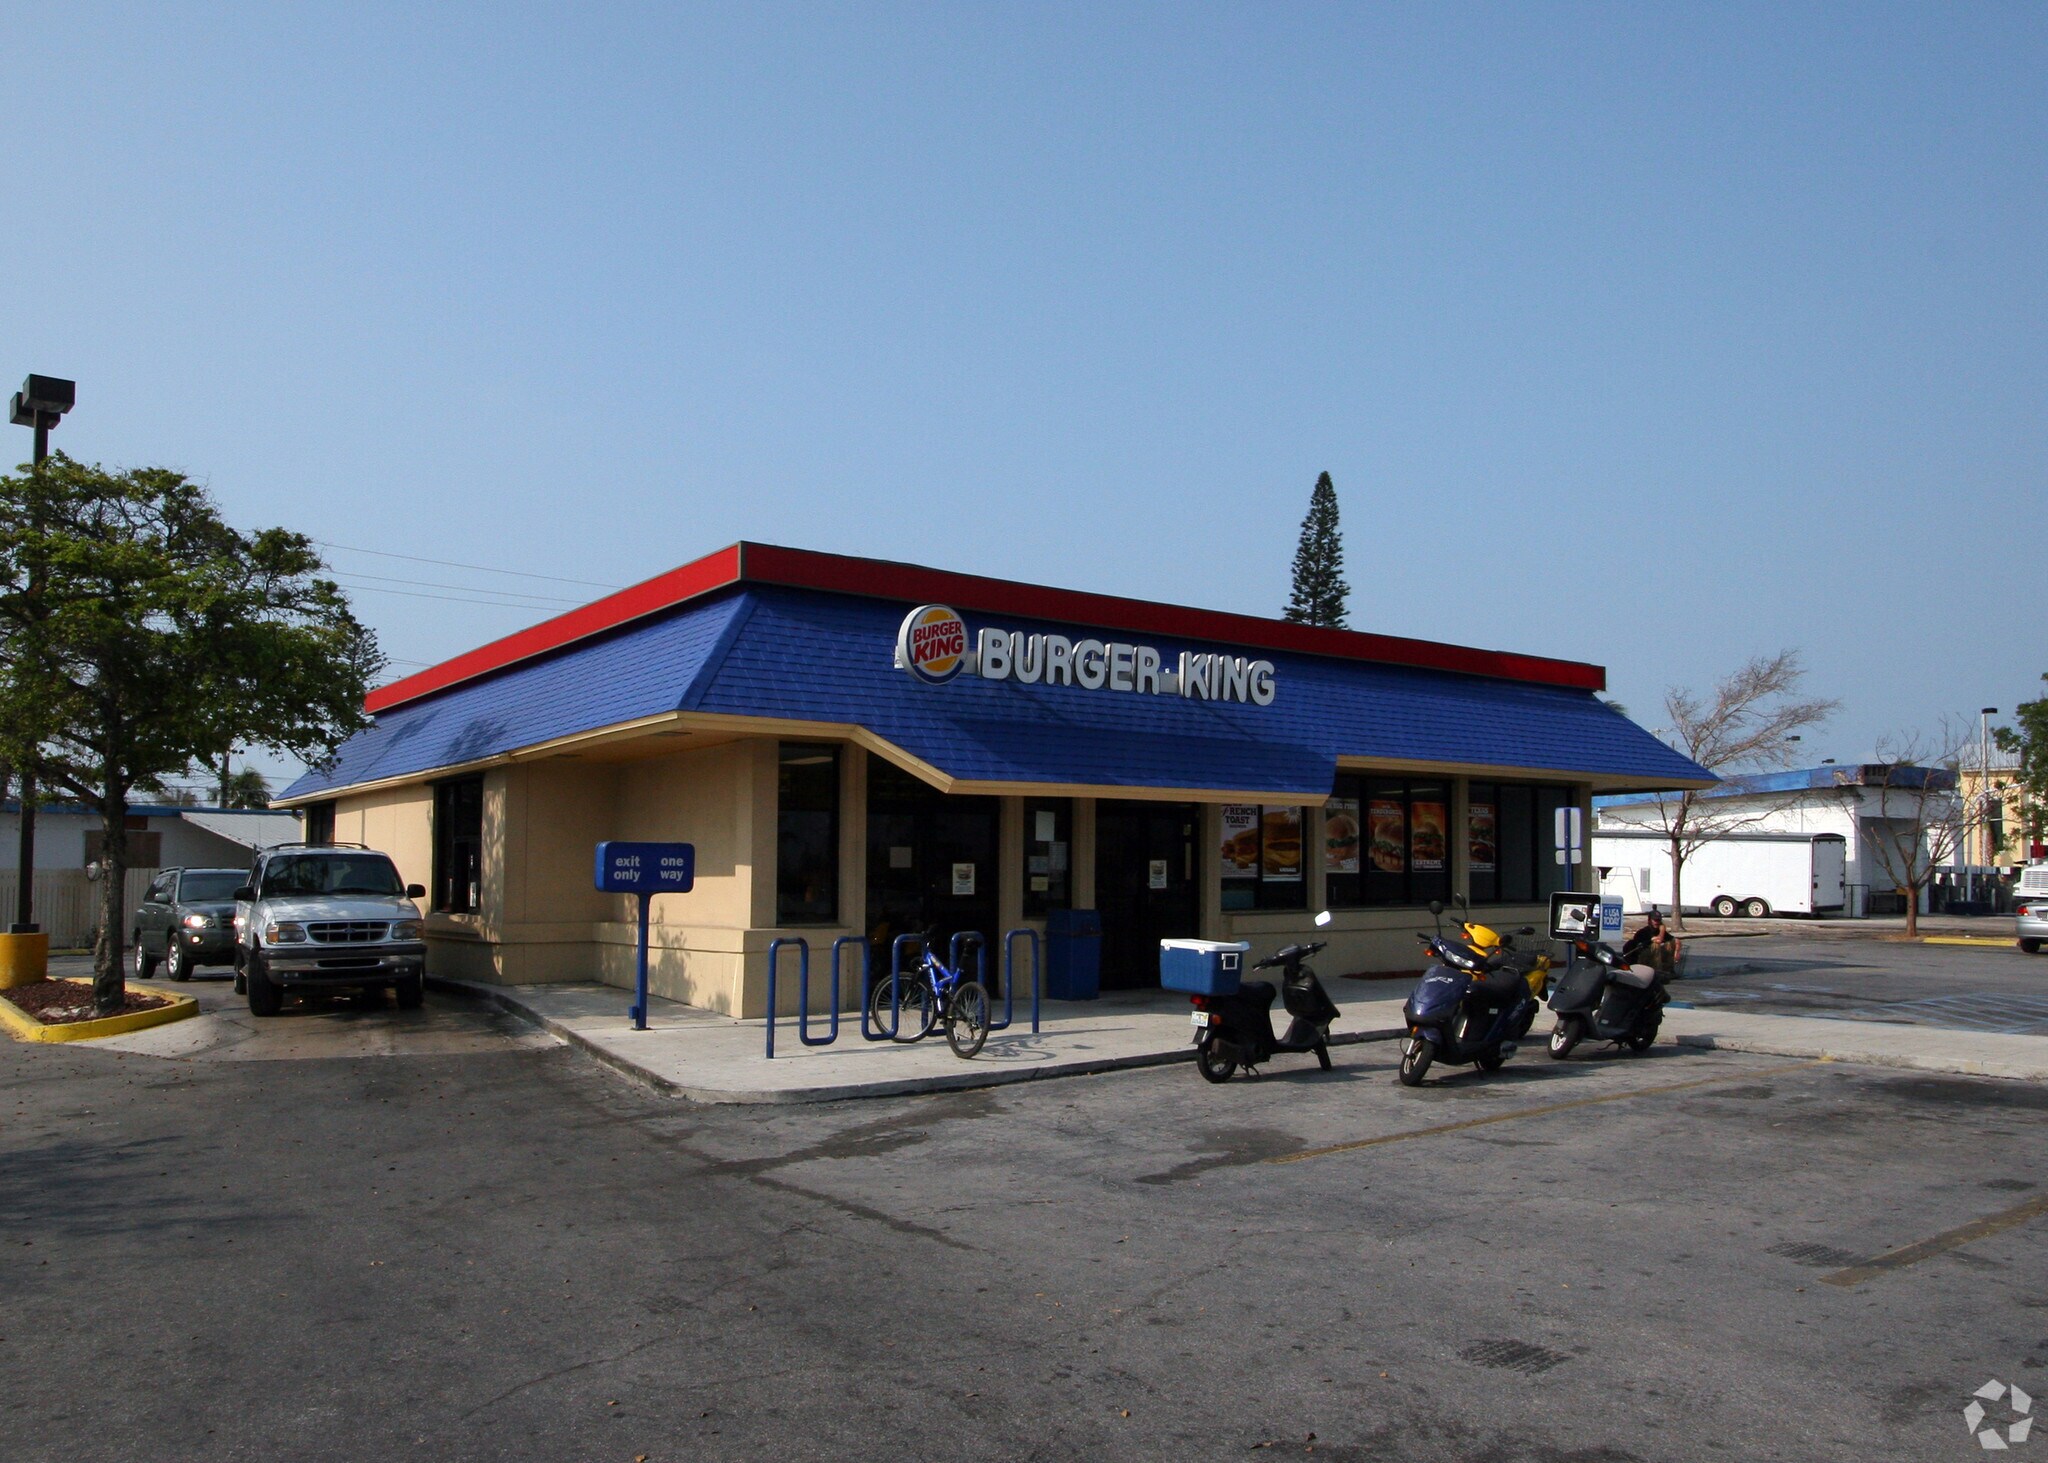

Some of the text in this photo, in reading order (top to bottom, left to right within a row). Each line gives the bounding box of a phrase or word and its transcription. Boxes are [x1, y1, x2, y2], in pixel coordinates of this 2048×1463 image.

[913, 621, 962, 644] BURGER
[913, 634, 964, 665] KING
[979, 627, 1276, 706] BURGER KING
[1225, 816, 1250, 824] TOAST
[615, 856, 640, 867] exit
[660, 857, 684, 866] one
[613, 869, 641, 882] only
[660, 870, 684, 882] way
[1608, 908, 1620, 917] USA
[1603, 916, 1620, 926] TODAY
